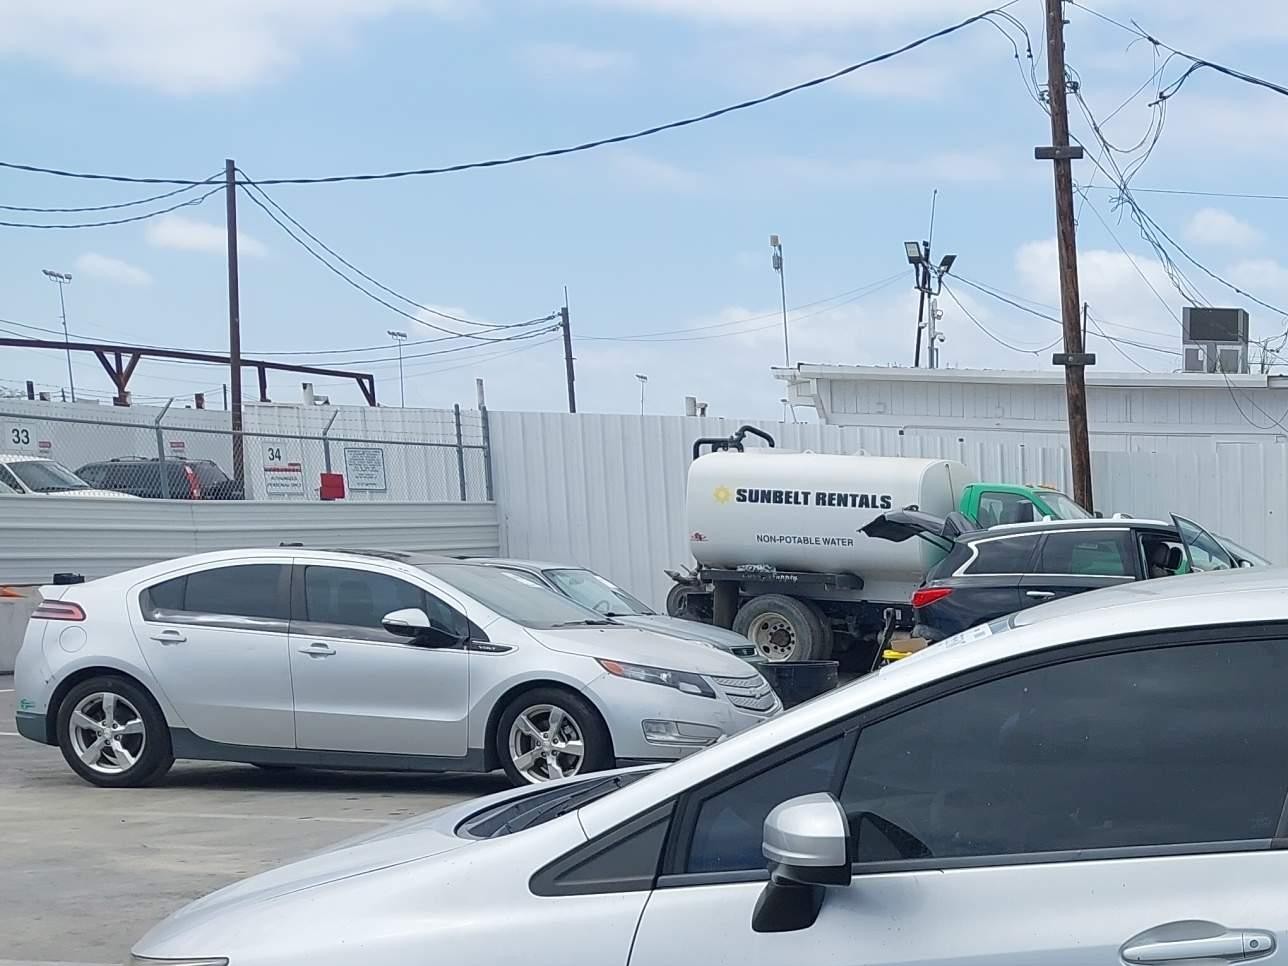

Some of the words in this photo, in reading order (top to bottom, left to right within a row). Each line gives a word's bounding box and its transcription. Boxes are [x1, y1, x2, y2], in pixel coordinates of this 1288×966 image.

[12, 428, 30, 445] 33
[267, 447, 281, 461] 34
[736, 488, 811, 506] SUNBELT
[815, 492, 892, 510] RENTALS
[756, 534, 821, 546] NON-POTABLE
[822, 537, 854, 547] WATER
